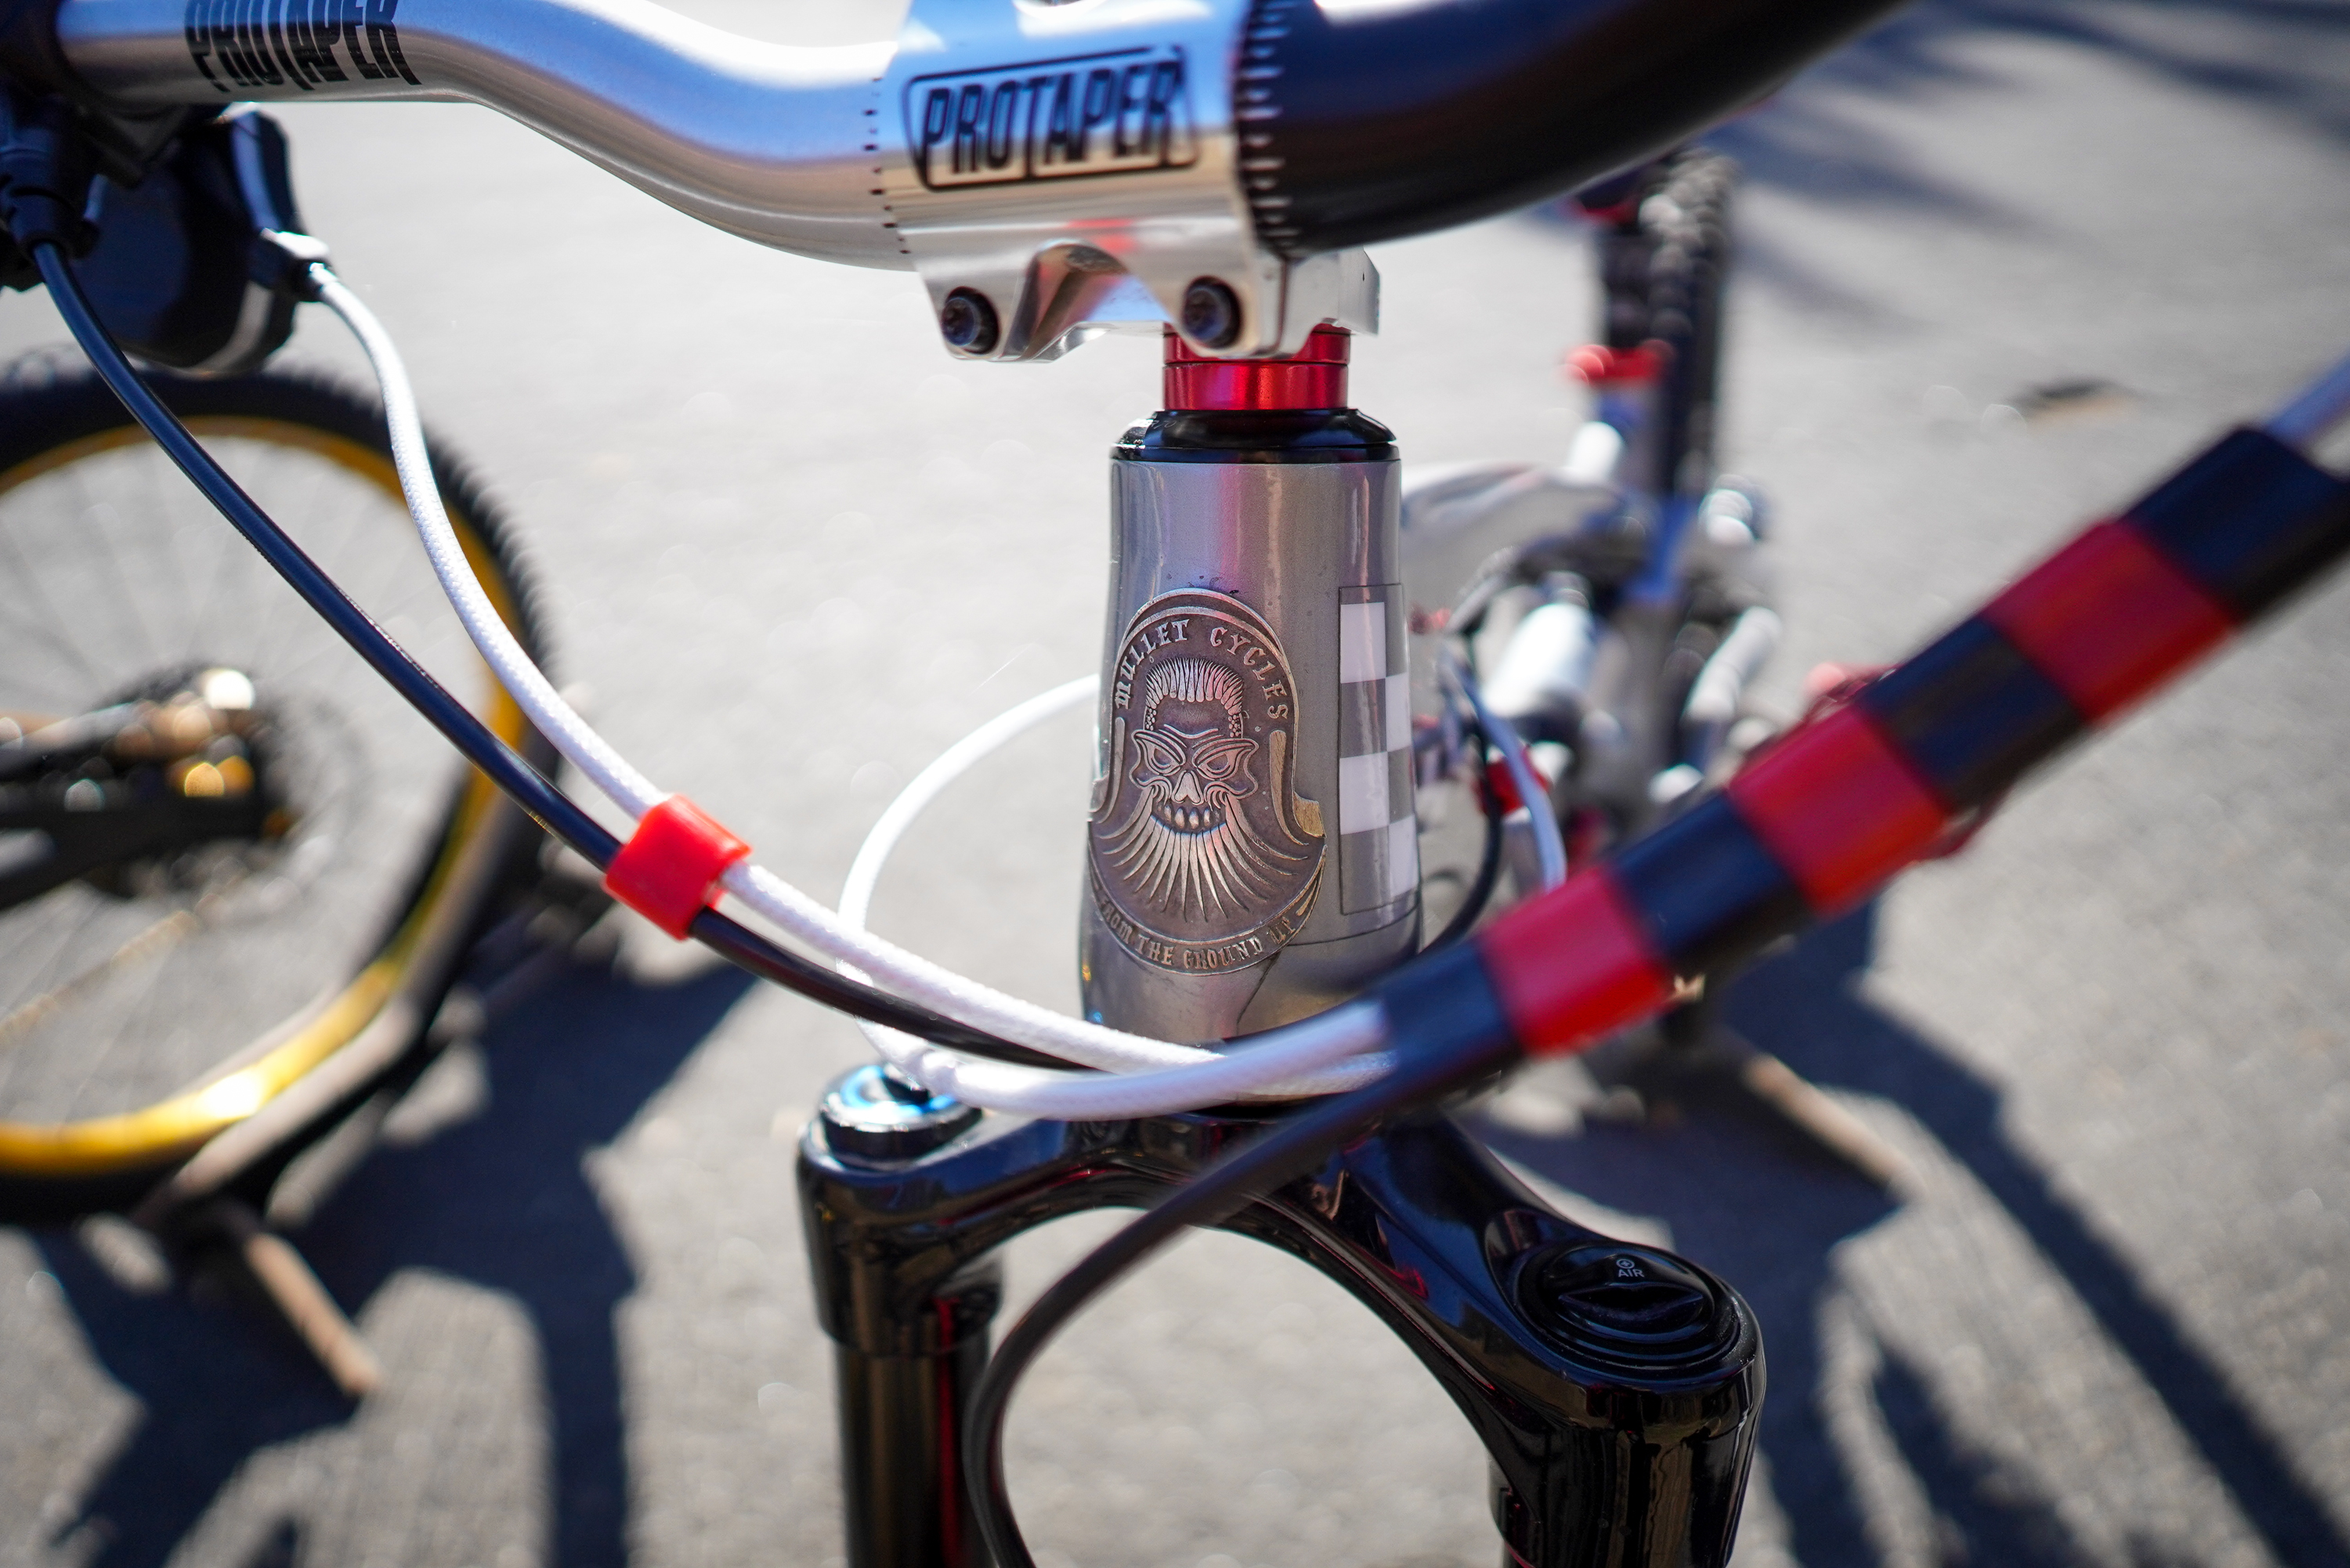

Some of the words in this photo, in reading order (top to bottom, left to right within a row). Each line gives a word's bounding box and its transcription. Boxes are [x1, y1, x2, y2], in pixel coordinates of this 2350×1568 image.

[916, 58, 1184, 179] PROTAPER
[1209, 627, 1289, 721] CYCLES
[1134, 934, 1175, 966] THE
[1183, 935, 1264, 970] GROUND
[1618, 1268, 1645, 1277] AIR
